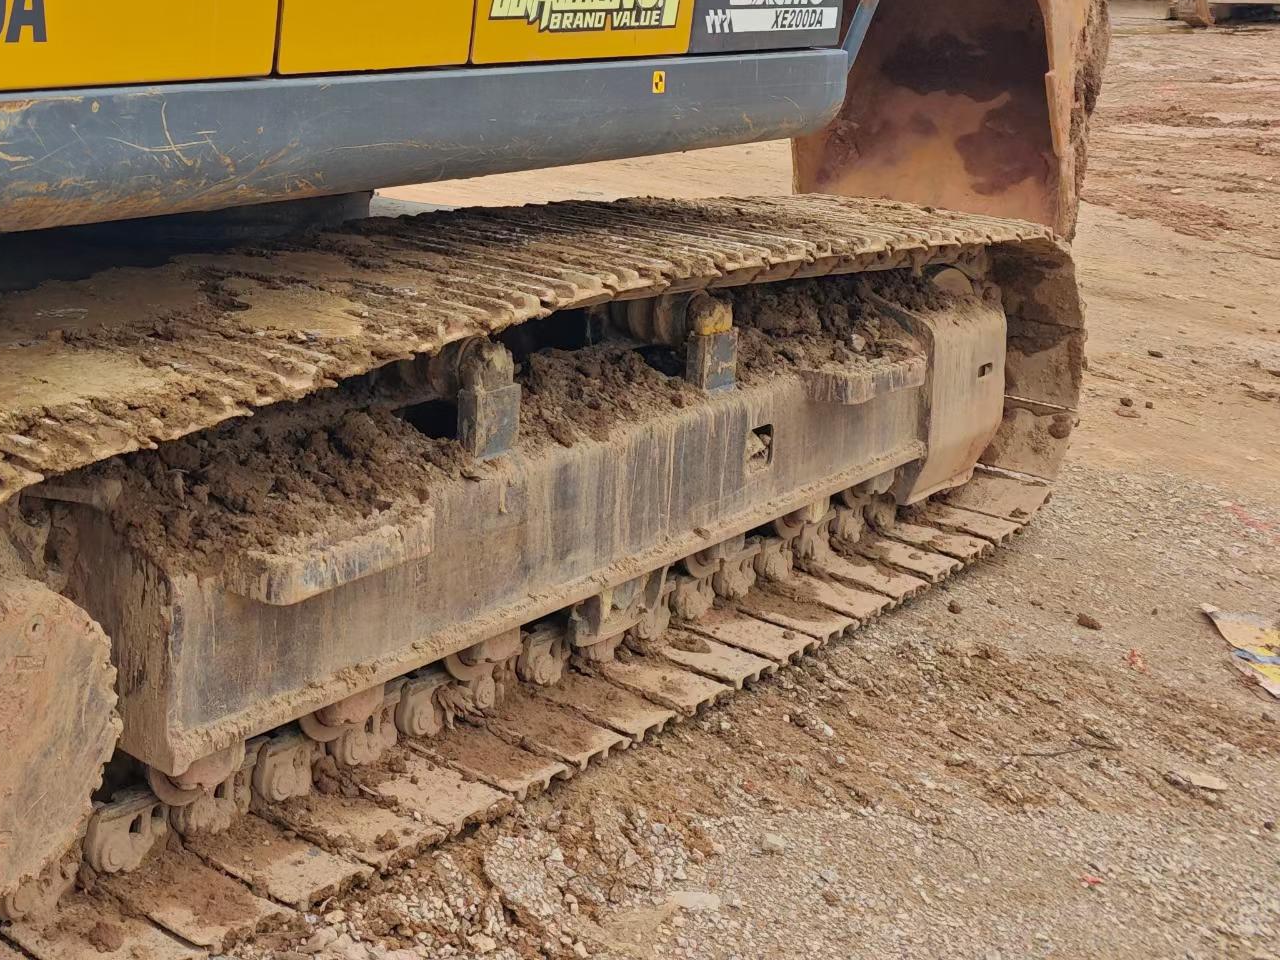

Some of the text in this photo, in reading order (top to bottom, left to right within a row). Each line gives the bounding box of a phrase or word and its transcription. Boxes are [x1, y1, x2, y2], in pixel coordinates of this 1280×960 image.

[549, 9, 661, 30] BRAND VALUE
[771, 8, 823, 29] XE200DA
